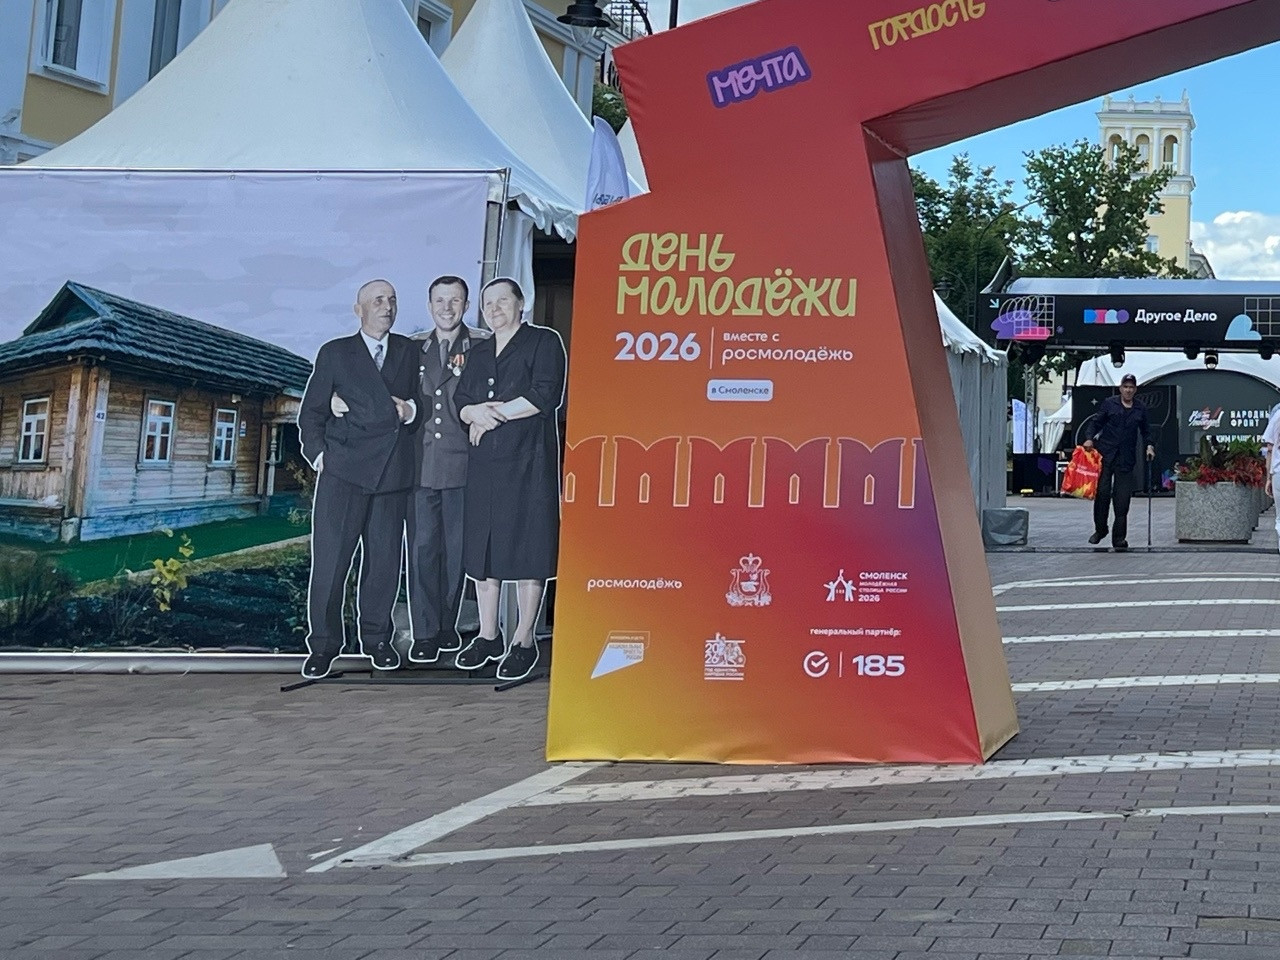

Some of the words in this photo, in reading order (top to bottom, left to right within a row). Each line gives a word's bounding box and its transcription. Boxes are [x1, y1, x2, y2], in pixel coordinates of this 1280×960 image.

[1134, 309, 1182, 324] Другое
[1183, 309, 1218, 323] Дело
[723, 332, 768, 342] вместе
[772, 332, 780, 342] с
[614, 331, 701, 361] 2026
[722, 346, 854, 366] росмолодёжь
[718, 385, 769, 395] Смоленске
[1230, 419, 1260, 428] ФРОНТ
[859, 572, 908, 580] СМОЛЕНСК
[587, 577, 683, 592] росмолодёжь
[858, 594, 881, 602] 2026
[810, 627, 864, 637] генеральный
[852, 654, 906, 677] 185
